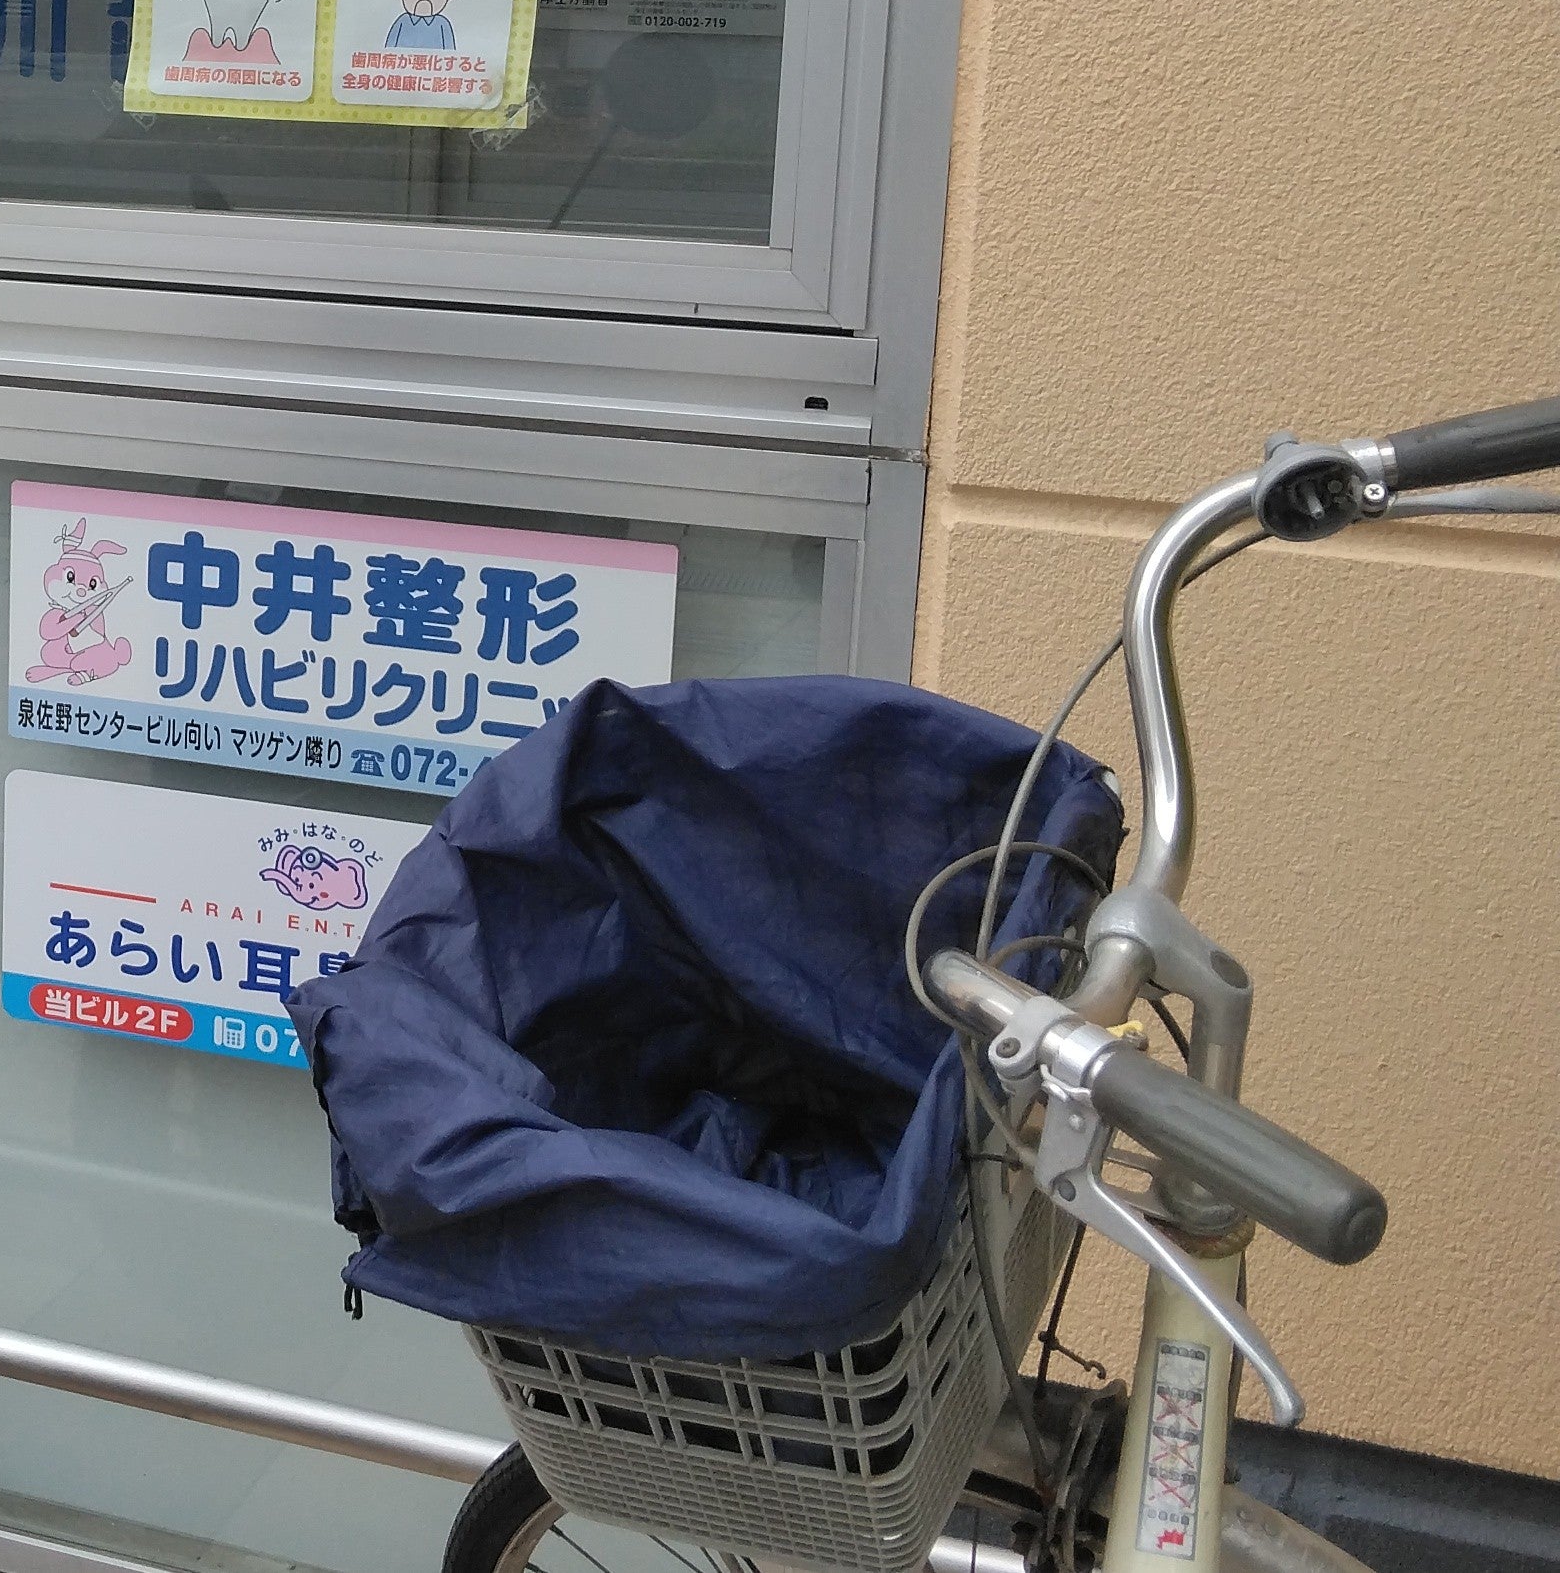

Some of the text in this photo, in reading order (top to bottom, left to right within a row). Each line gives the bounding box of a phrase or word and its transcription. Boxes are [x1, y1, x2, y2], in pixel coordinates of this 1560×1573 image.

[645, 16, 727, 29] 0120-002-719
[351, 52, 486, 73] 歯周病が悪化すると
[164, 66, 302, 87] 歯周病の原因になる
[342, 74, 493, 95] 全身の健康に影響する
[147, 530, 580, 665] 中井整形
[17, 696, 492, 788] 泉佐野センタービル向い マツゲン隣り 072-
[180, 898, 263, 925] ARAI
[44, 988, 180, 1034] 当ビル2F
